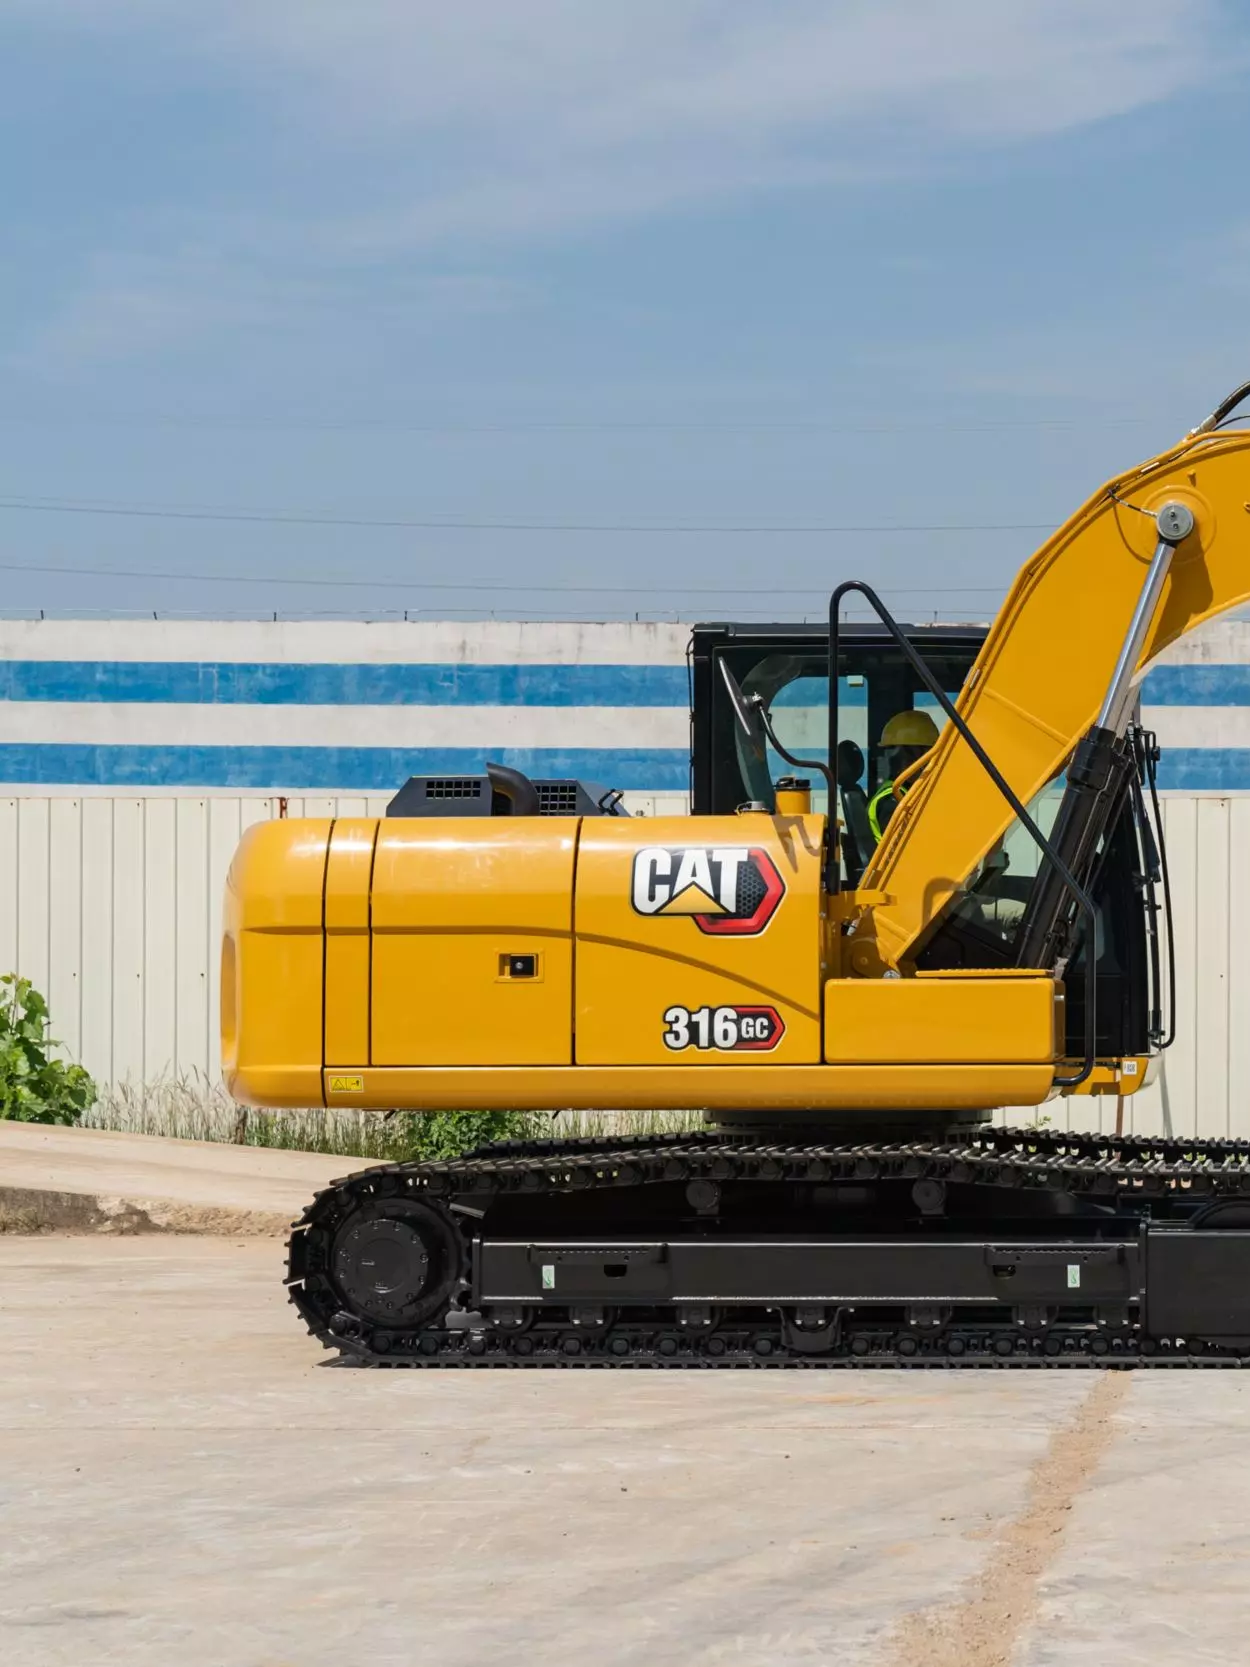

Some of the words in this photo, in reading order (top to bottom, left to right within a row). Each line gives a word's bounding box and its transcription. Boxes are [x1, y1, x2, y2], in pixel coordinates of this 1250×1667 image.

[633, 848, 749, 914] CAT
[664, 1006, 738, 1049] 316
[741, 1017, 769, 1039] GC
